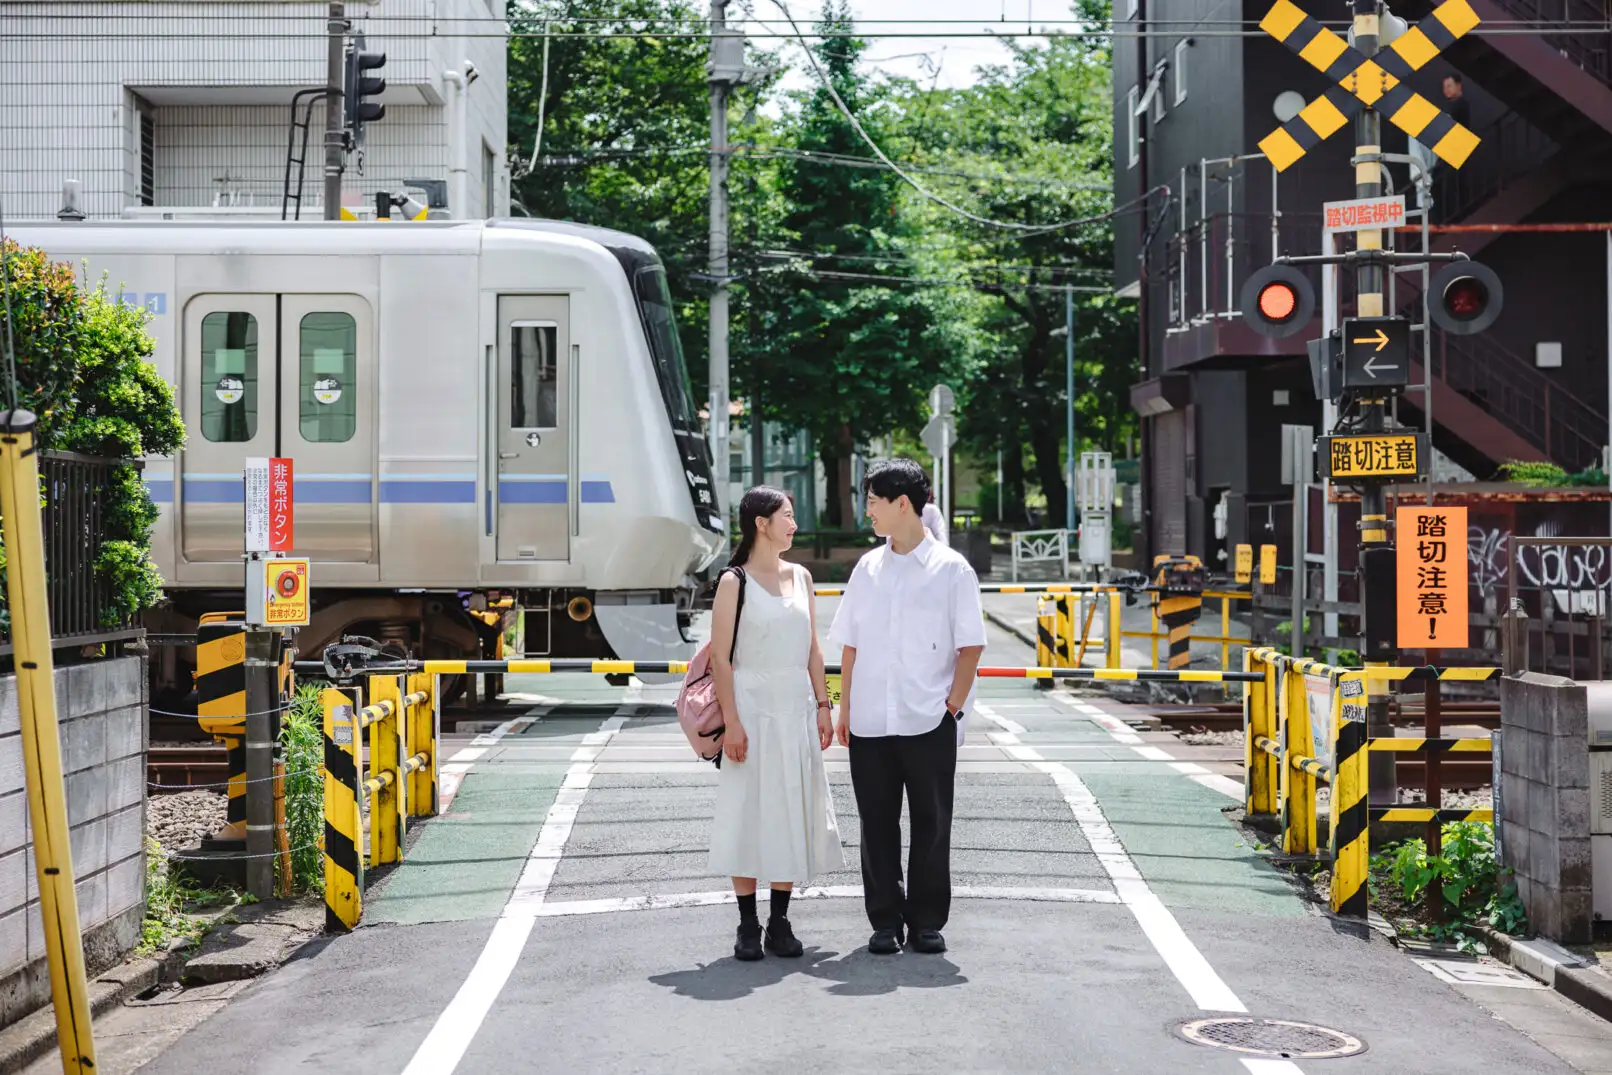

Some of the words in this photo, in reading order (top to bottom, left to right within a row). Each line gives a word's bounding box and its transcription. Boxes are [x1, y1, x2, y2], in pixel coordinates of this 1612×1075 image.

[1326, 202, 1403, 228] 踏切監視中
[1332, 440, 1415, 471] 踏切注意
[273, 463, 288, 545] 非常ボタン
[270, 609, 304, 619] 非常ボタン
